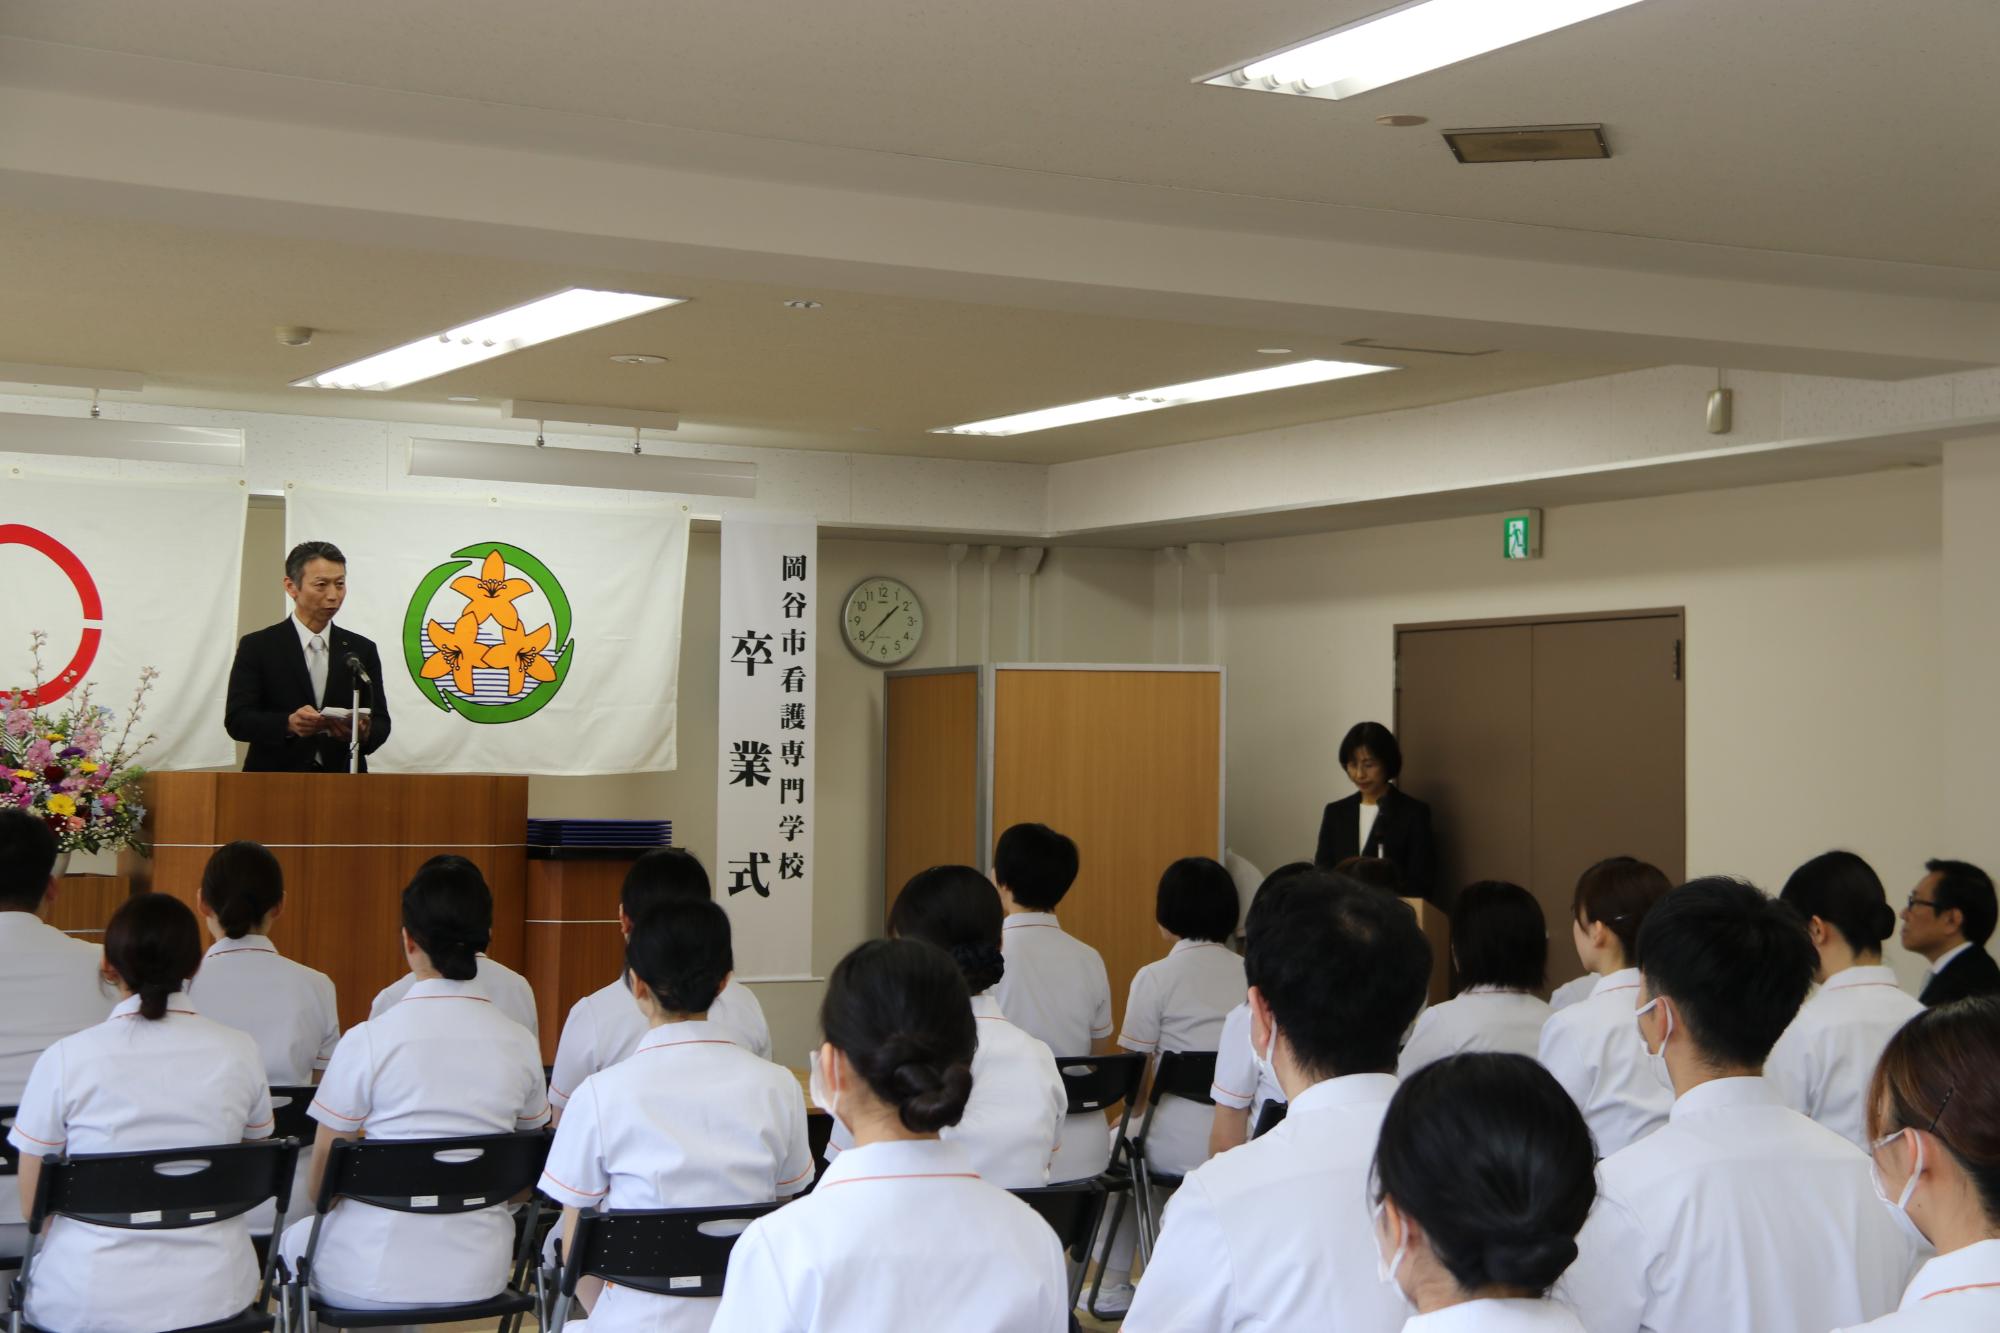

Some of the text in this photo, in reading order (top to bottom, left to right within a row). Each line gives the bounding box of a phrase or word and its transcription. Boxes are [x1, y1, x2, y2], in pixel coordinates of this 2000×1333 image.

[865, 591, 873, 601] 11
[878, 586, 889, 598] 12
[894, 591, 898, 601] 1
[902, 601, 909, 612] 2
[854, 615, 861, 626] 9
[907, 616, 914, 627] 3
[858, 630, 865, 641] 8
[903, 631, 909, 640] 4
[868, 640, 875, 650] 7
[880, 644, 887, 655] 6
[894, 640, 901, 651] 5
[778, 554, 807, 880] 岡谷市看護専門学校
[728, 630, 774, 898] 卒業式
